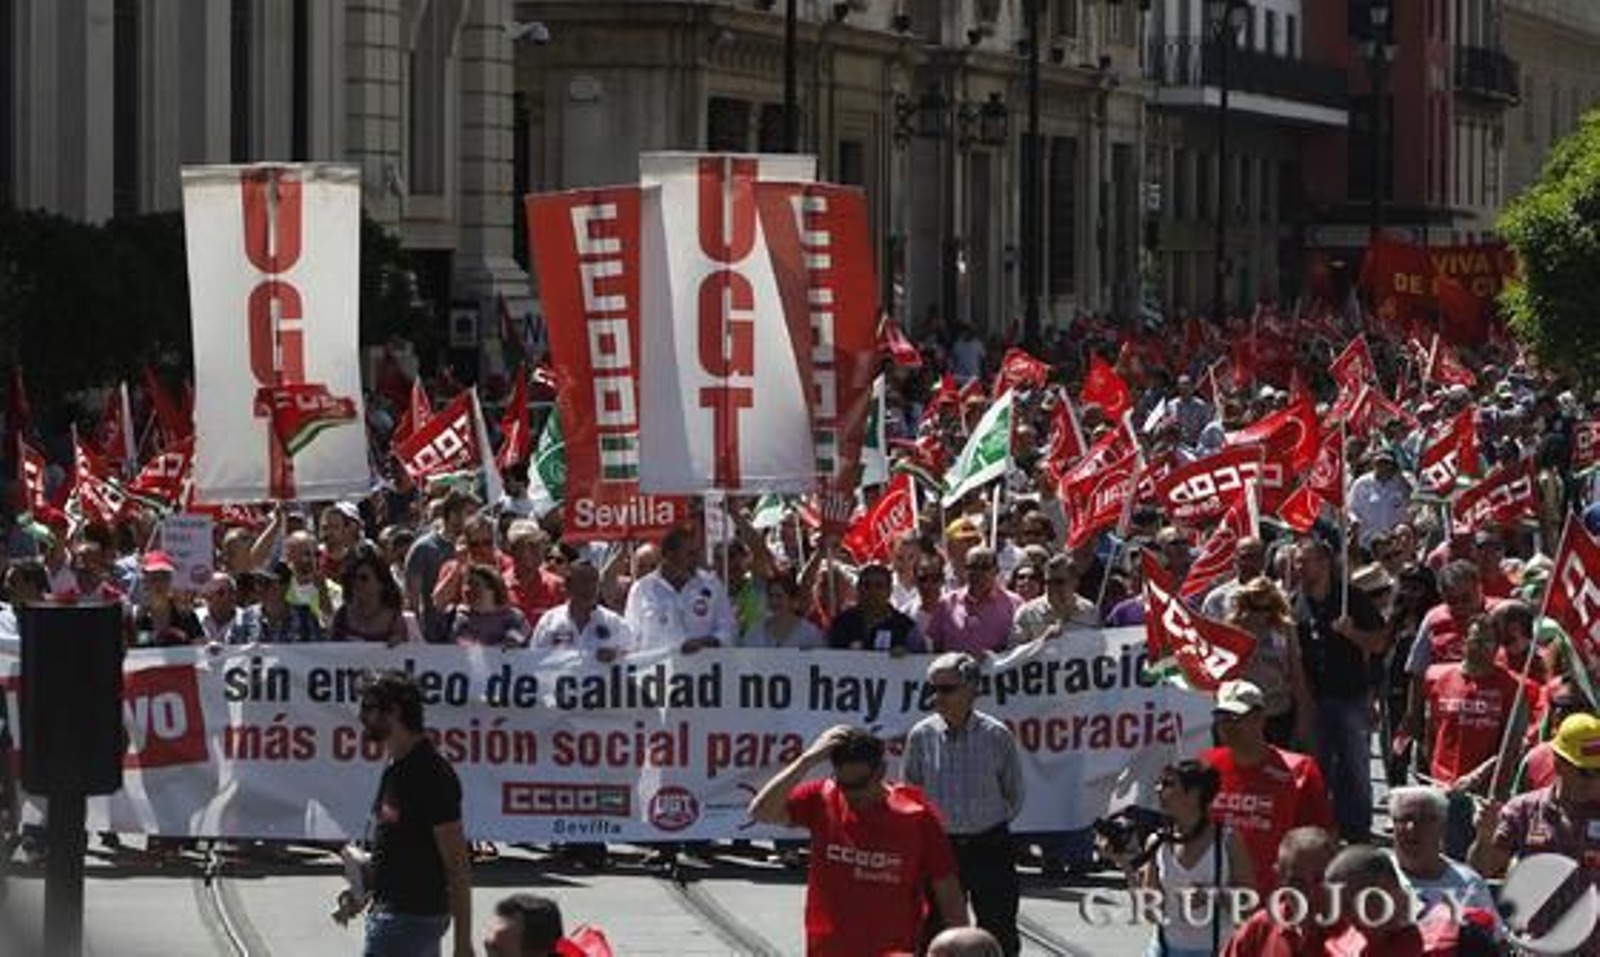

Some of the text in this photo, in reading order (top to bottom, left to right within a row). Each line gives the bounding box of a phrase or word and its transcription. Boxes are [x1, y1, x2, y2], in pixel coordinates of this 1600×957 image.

[571, 203, 637, 426] CCOO
[698, 157, 759, 489] UGT
[574, 496, 675, 527] Sevilla
[223, 658, 291, 703] sin
[308, 659, 469, 707] emeo
[486, 664, 537, 709] de
[555, 662, 723, 709] calidad
[739, 674, 791, 709] no
[809, 665, 888, 722] hay
[123, 691, 189, 754] yo
[223, 714, 803, 778] más cosión social para
[1005, 701, 1183, 756] ocracia
[509, 786, 597, 811] CCOO
[553, 818, 621, 835] Sevilla
